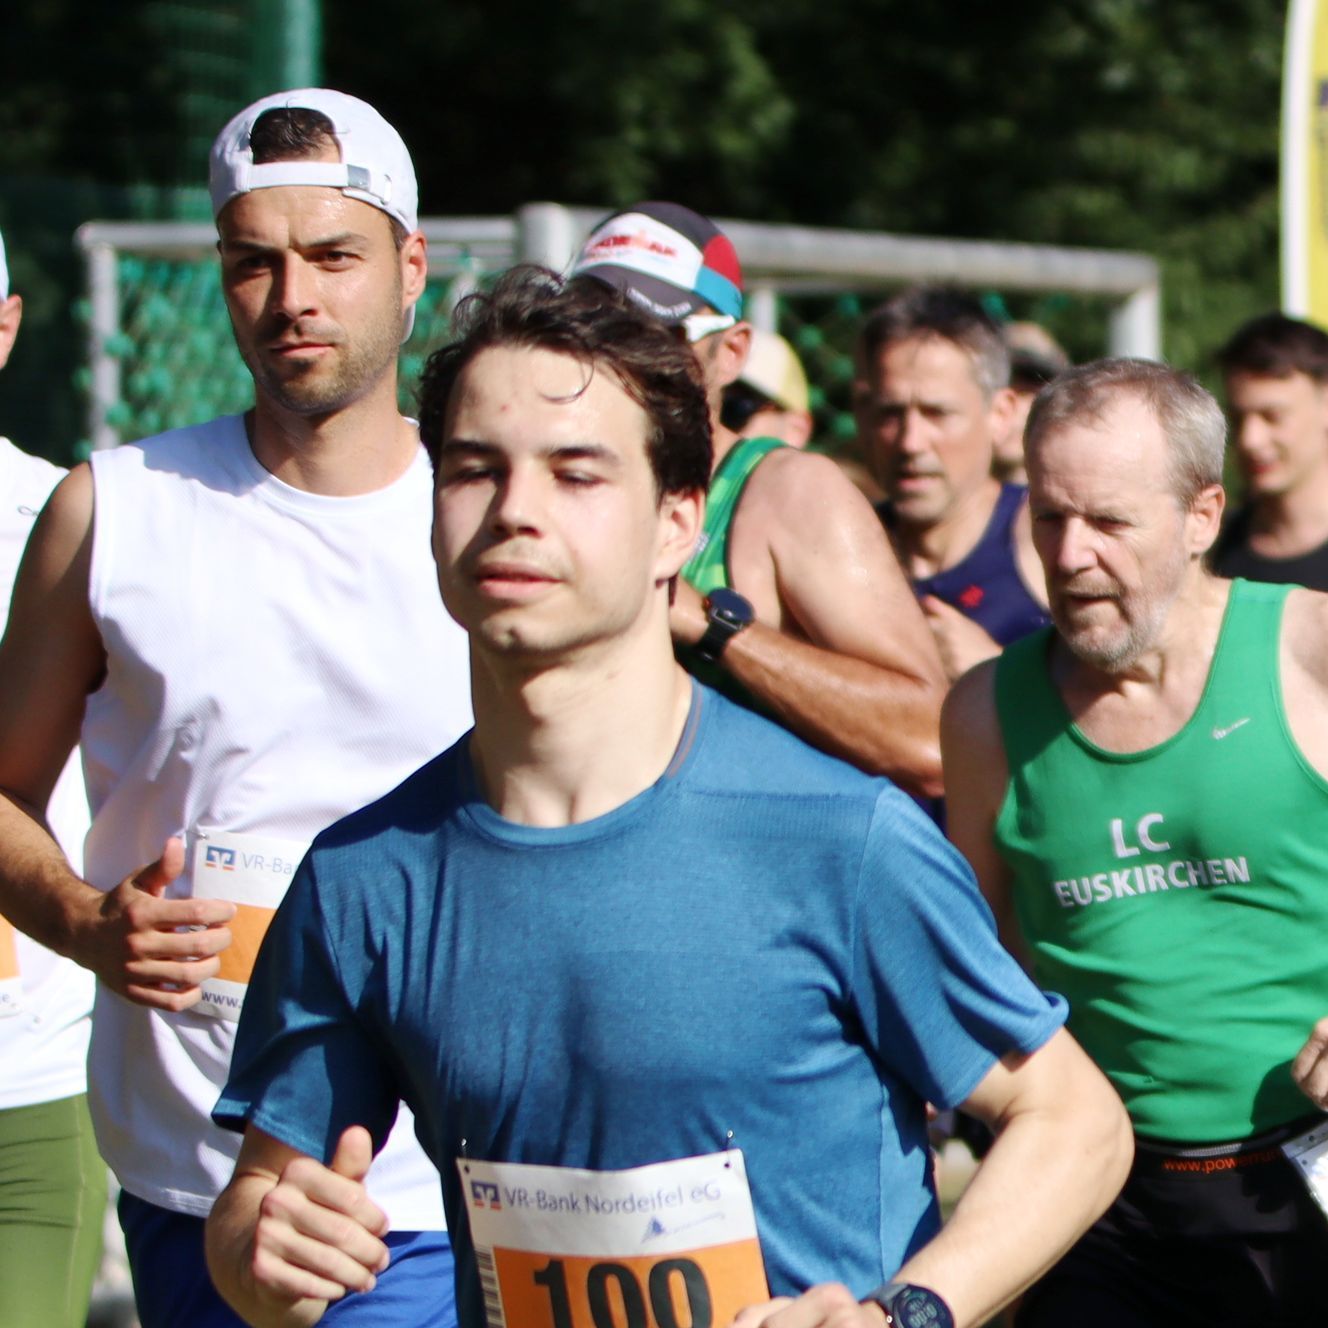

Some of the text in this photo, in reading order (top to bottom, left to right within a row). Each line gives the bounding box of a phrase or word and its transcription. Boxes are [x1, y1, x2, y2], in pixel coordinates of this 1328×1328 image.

[1111, 813, 1171, 859] LC
[241, 853, 293, 875] VR-Ba
[1054, 856, 1251, 908] EUSKIRCHEN
[504, 1182, 721, 1215] VR-Bank Nordeifel eG
